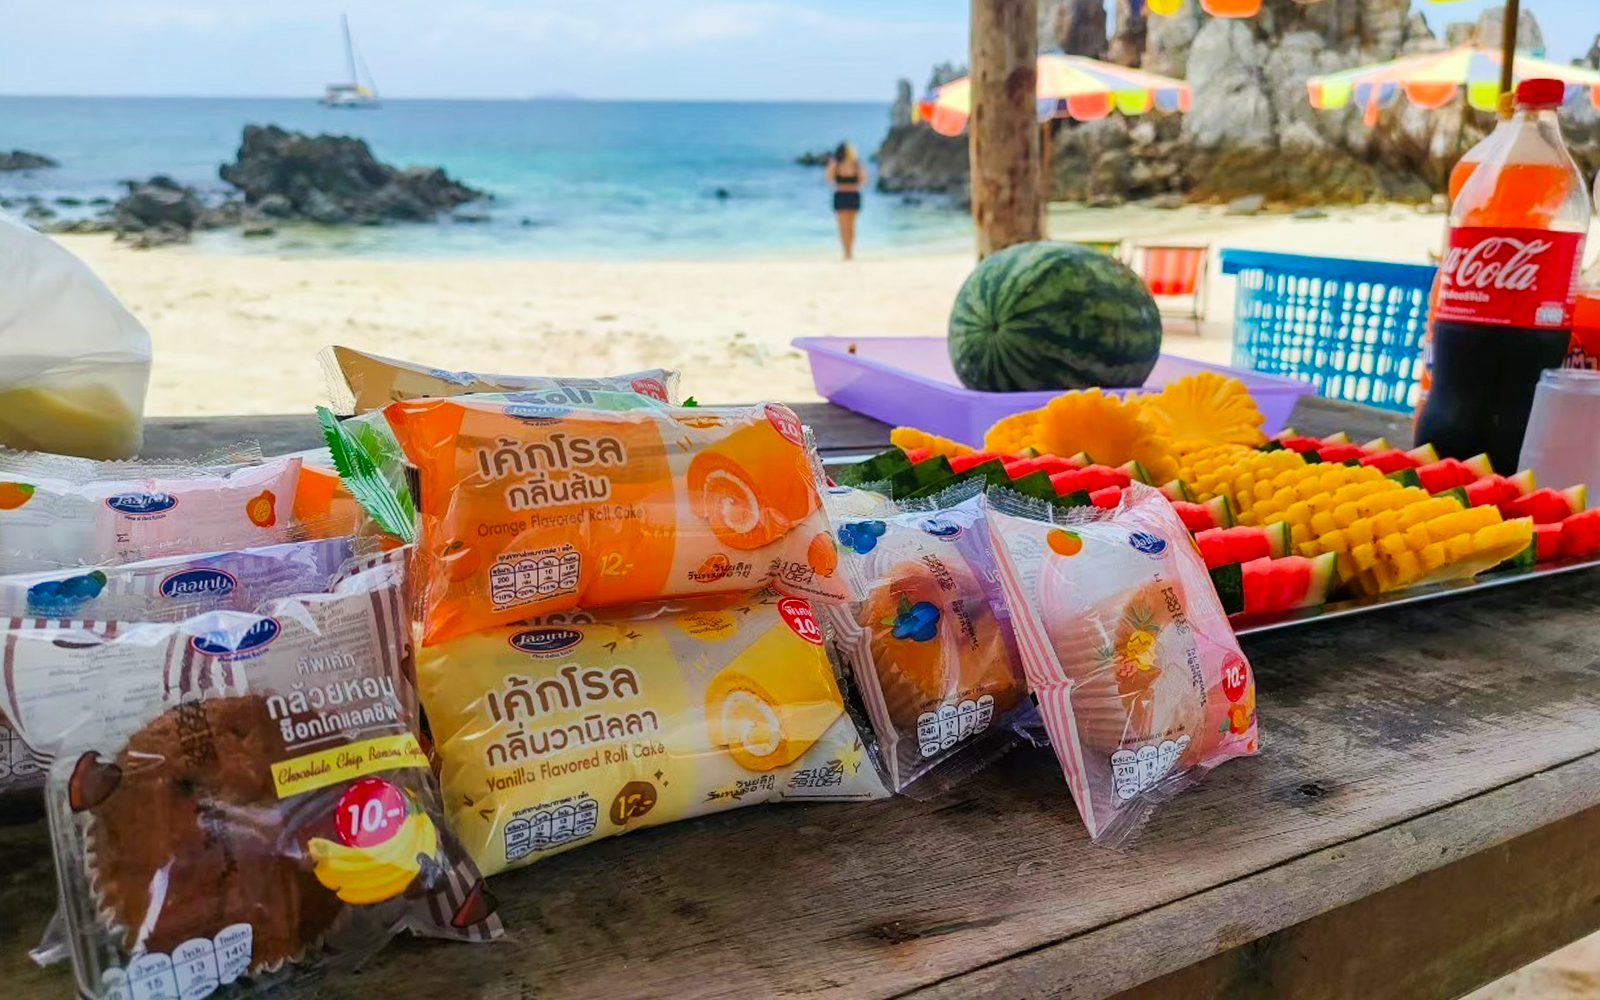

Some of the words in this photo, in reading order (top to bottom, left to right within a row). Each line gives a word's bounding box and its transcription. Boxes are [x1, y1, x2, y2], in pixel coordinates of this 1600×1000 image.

[477, 432, 624, 477] เค้กโรล
[507, 474, 609, 510] กลิ่นส้ม
[477, 519, 527, 537] Orange
[531, 511, 585, 529] Flavored
[589, 507, 611, 521] Roll
[614, 504, 644, 519] Cake
[265, 675, 395, 720] กล้วยหอม
[486, 664, 640, 723] เค้กโรล
[486, 707, 660, 767] กลิ่นวานิลลา
[278, 760, 331, 786] Chocolate
[336, 750, 363, 770] Chip
[486, 767, 536, 793] Vanilla
[540, 754, 601, 780] Flavored
[631, 740, 667, 760] Cake
[346, 797, 401, 837] 10.-
